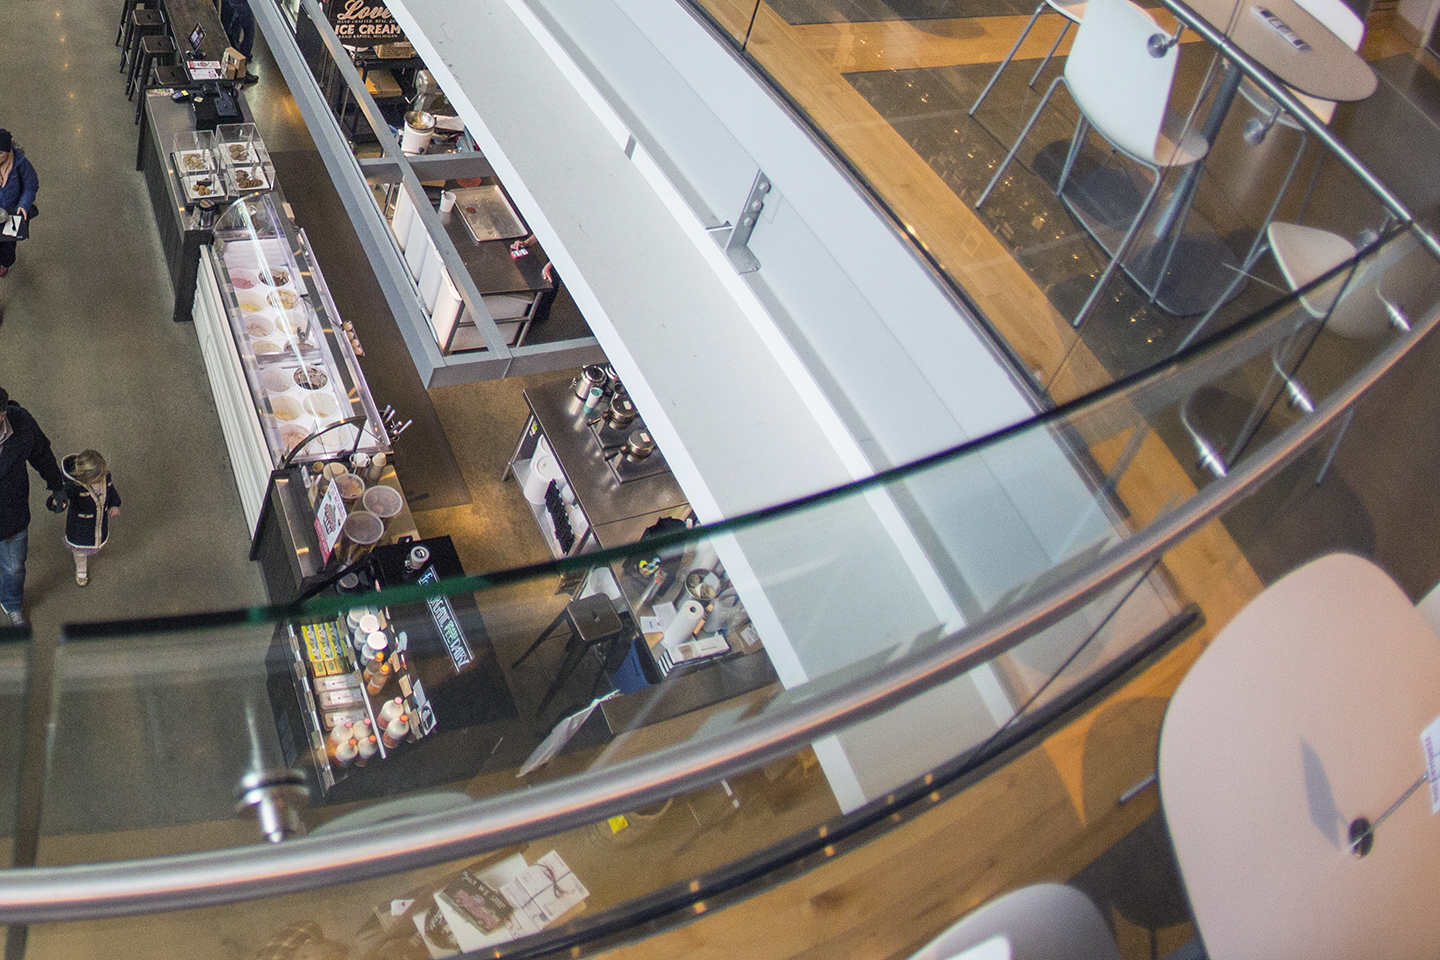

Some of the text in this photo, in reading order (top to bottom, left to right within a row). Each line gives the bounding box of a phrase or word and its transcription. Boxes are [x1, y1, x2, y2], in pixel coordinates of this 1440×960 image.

[335, 24, 401, 35] ICE CREAM
[450, 637, 470, 667] DAIRY
